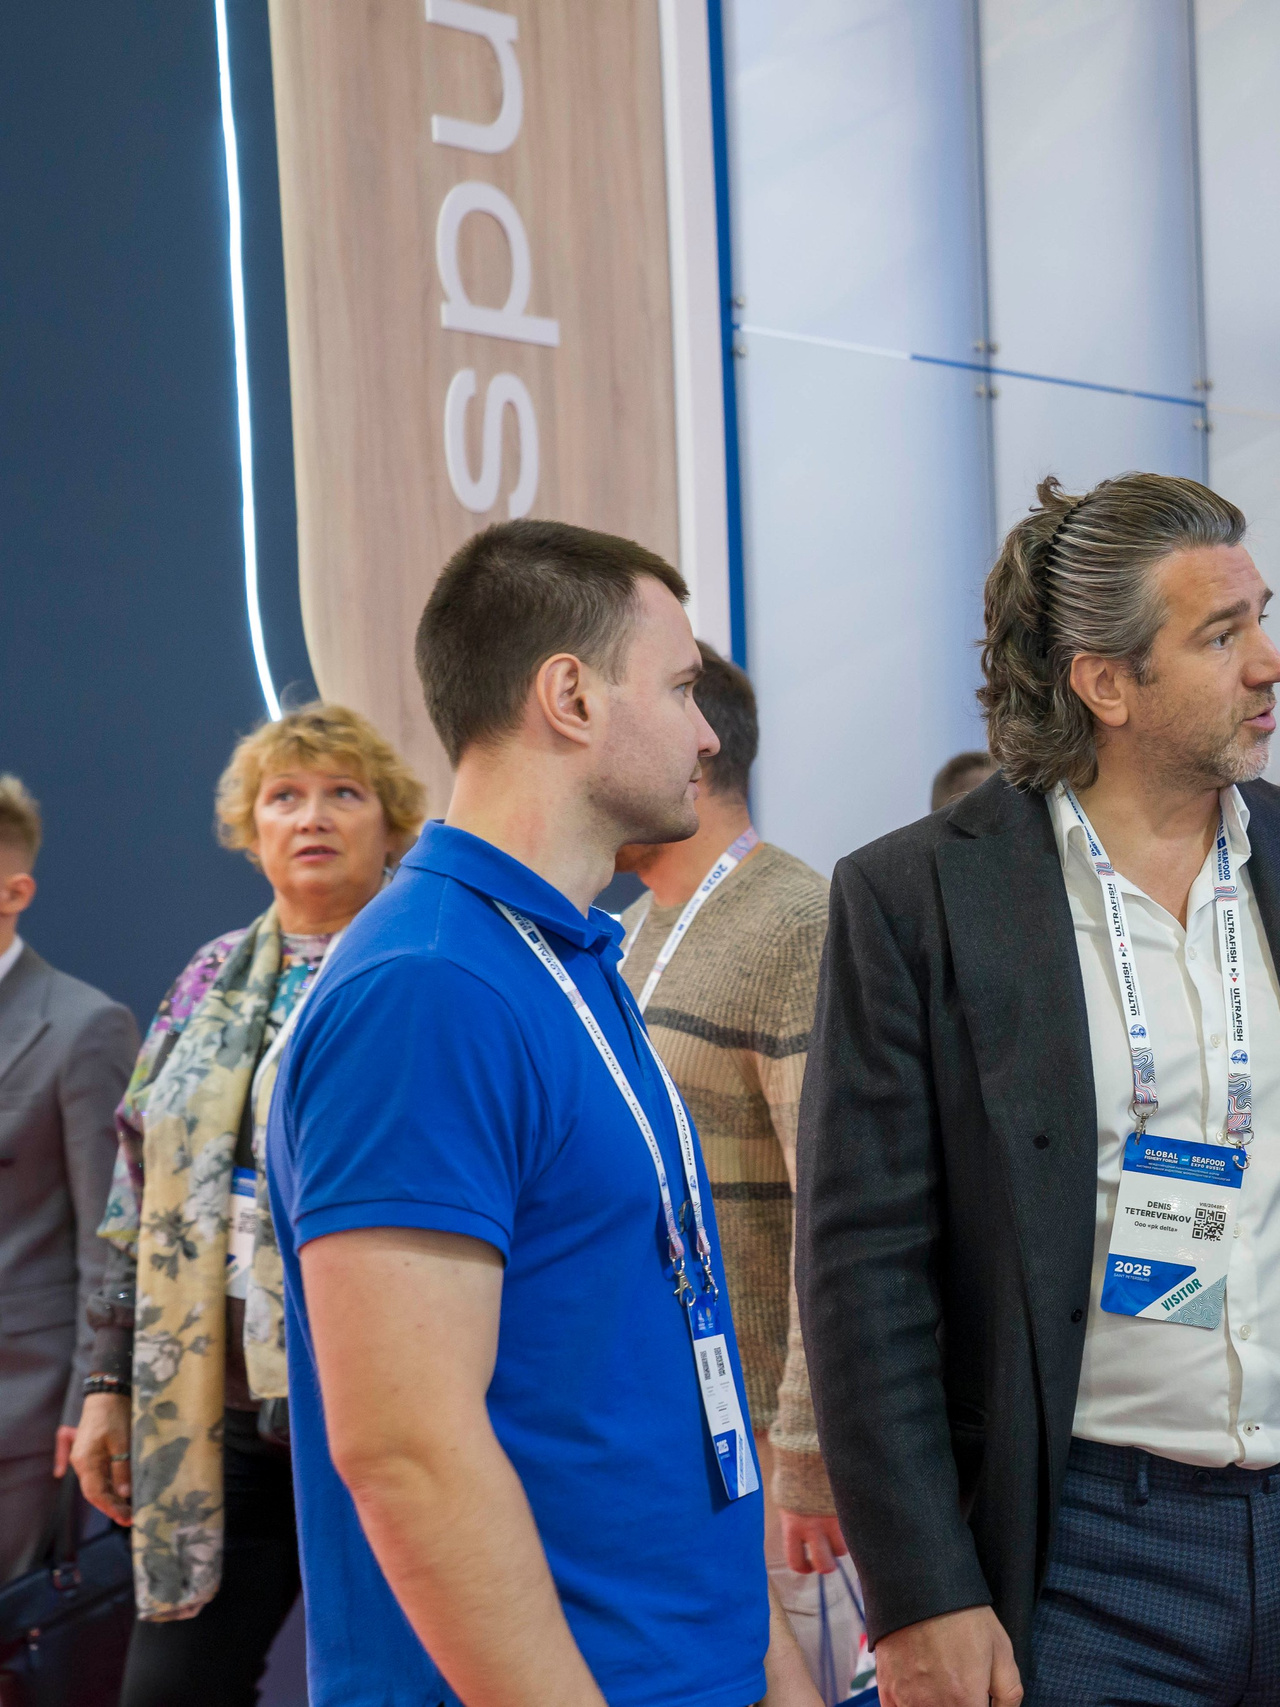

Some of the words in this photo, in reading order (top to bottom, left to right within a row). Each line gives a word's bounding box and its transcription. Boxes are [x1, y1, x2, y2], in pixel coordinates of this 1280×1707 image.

[1222, 848, 1231, 881] SEAFOOD
[1107, 883, 1122, 937] ULTRAFISH
[1226, 909, 1238, 963] ULTRAFISH
[1122, 962, 1137, 1016] ULTRAFISH
[1233, 987, 1244, 1042] ULTRAFISH
[1145, 1148, 1178, 1160] GLOBAL
[1191, 1156, 1226, 1167] SEAFOOD
[1205, 1164, 1225, 1172] RUSSIA
[1125, 1206, 1192, 1224] TETEREVENKOV
[1147, 1200, 1172, 1211] DENIS
[1114, 1261, 1152, 1277] 2025
[1161, 1278, 1203, 1312] VISITOR
